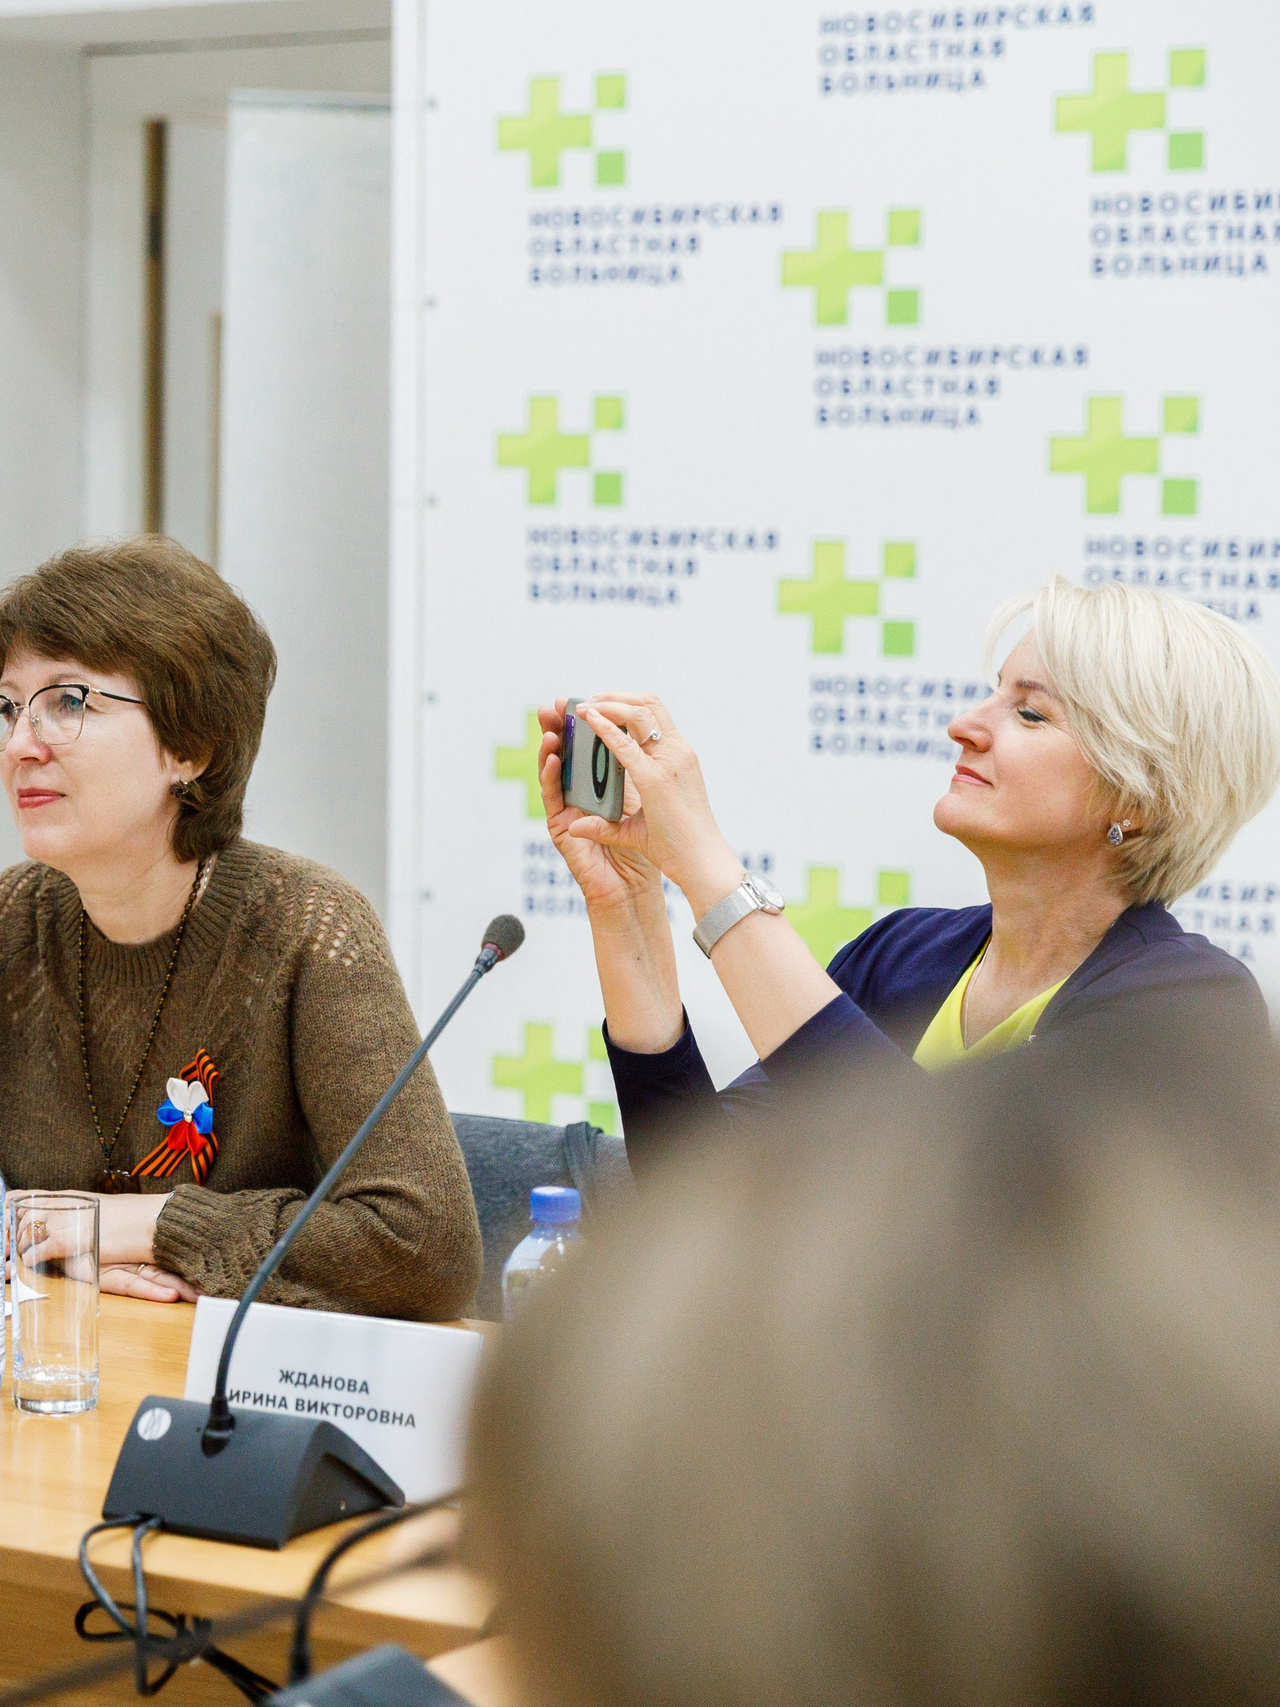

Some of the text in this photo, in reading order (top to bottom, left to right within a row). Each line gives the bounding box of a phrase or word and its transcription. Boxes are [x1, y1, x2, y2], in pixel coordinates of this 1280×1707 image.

[821, 4, 1094, 33] НОВОСИБИРСКАЯ
[820, 38, 1006, 63] ОБЛАСТНАЯ
[820, 69, 984, 94] БОЛЬНИЦА
[530, 203, 782, 228] НОВОСИБИРСКАЯ
[1090, 190, 1280, 217] НОВОСИБИ
[529, 232, 700, 259] ОБЛАСТНАЯ
[530, 263, 681, 287] БОЛЬНИЦА
[1090, 253, 1268, 279] БОЛЬНИЦА
[816, 346, 1087, 370] НОВОСИБИРСКАЯ
[815, 375, 1001, 400] ОБЛАСТНАЯ
[816, 406, 982, 430] БОЛЬНИЦА
[528, 527, 780, 550] НОВОСИБИРСКАЯ
[527, 556, 699, 580] ОБЛАСТНАЯ
[528, 582, 681, 608] БОЛЬНИЦА
[810, 705, 970, 729] ОБЛАСТН
[811, 734, 961, 760] БОЛЬНИЦ
[278, 1369, 370, 1395] ЖДАНОВА
[228, 1388, 417, 1429] ИРИНА ВИКТОРОВНА
